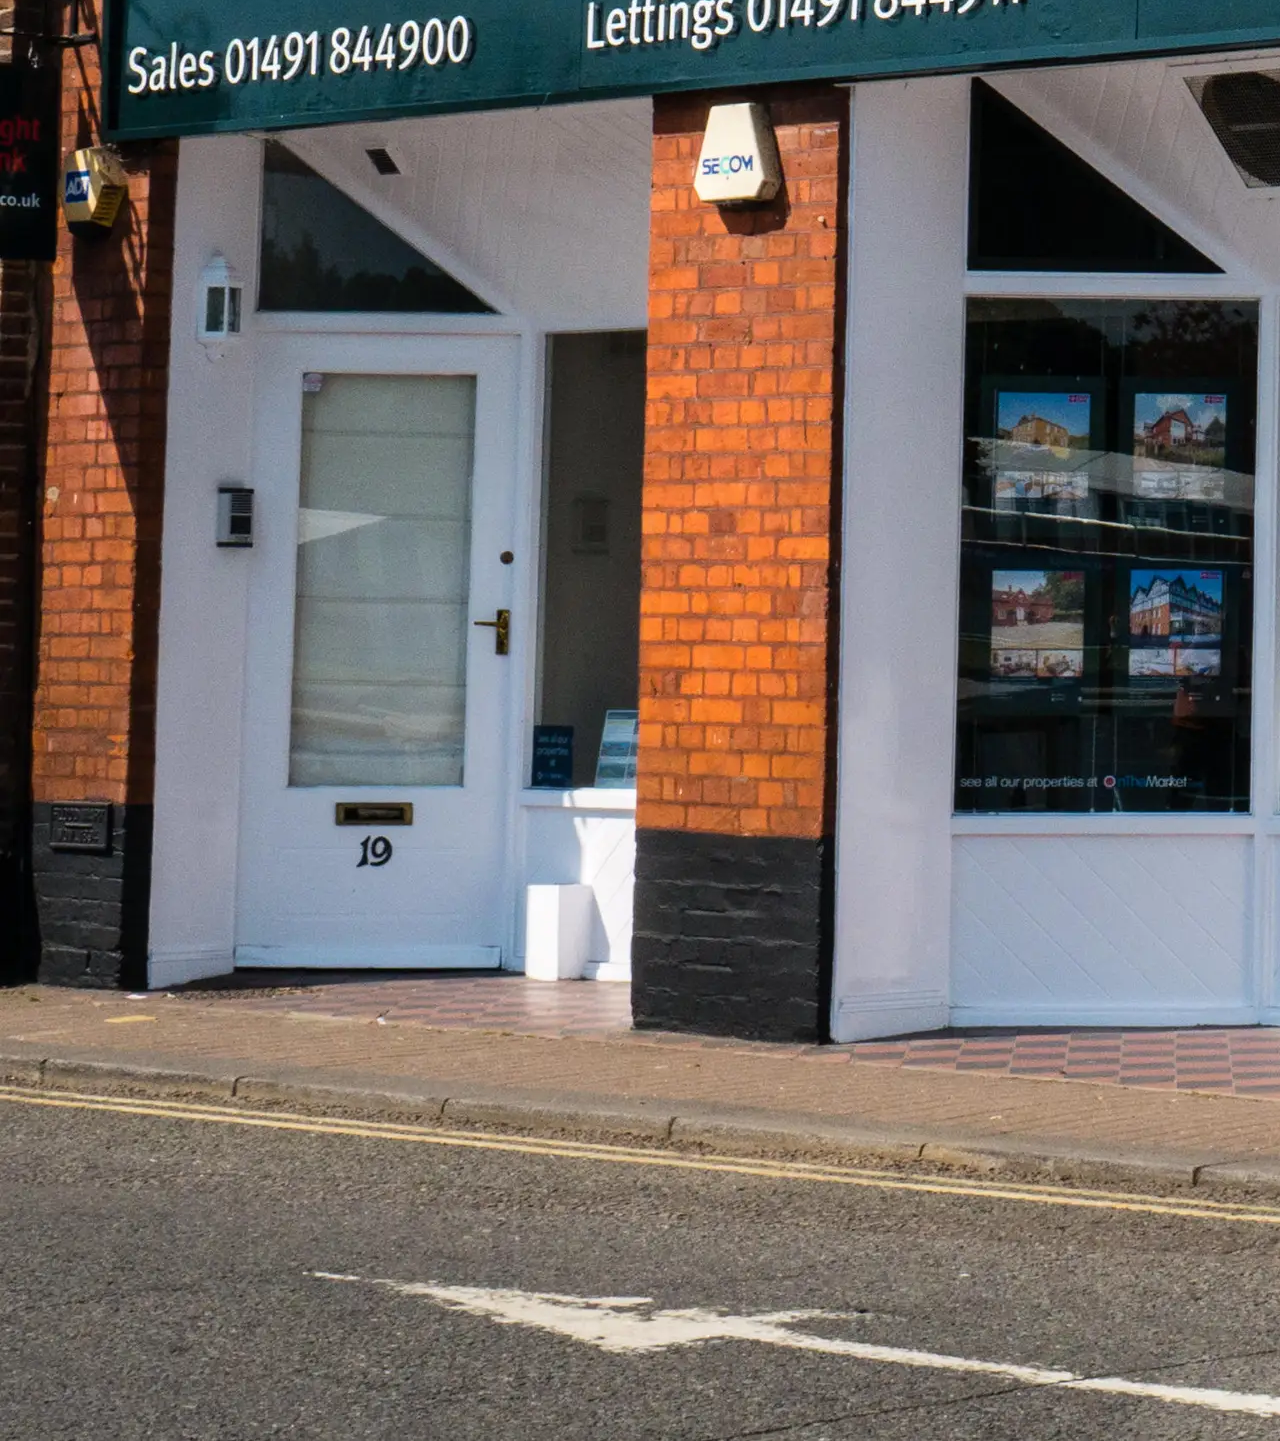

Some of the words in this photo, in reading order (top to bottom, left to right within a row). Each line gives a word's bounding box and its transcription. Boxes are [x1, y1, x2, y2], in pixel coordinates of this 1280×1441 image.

[126, 45, 215, 96] Sales
[225, 31, 318, 82] 01491
[330, 16, 470, 75] 844900
[702, 155, 753, 176] SECOM
[66, 177, 90, 196] ADT
[960, 776, 981, 788] see
[985, 775, 997, 788] all
[1000, 776, 1019, 788] our
[1023, 775, 1084, 790] properties
[1086, 775, 1098, 788] at
[356, 835, 393, 868] 19
